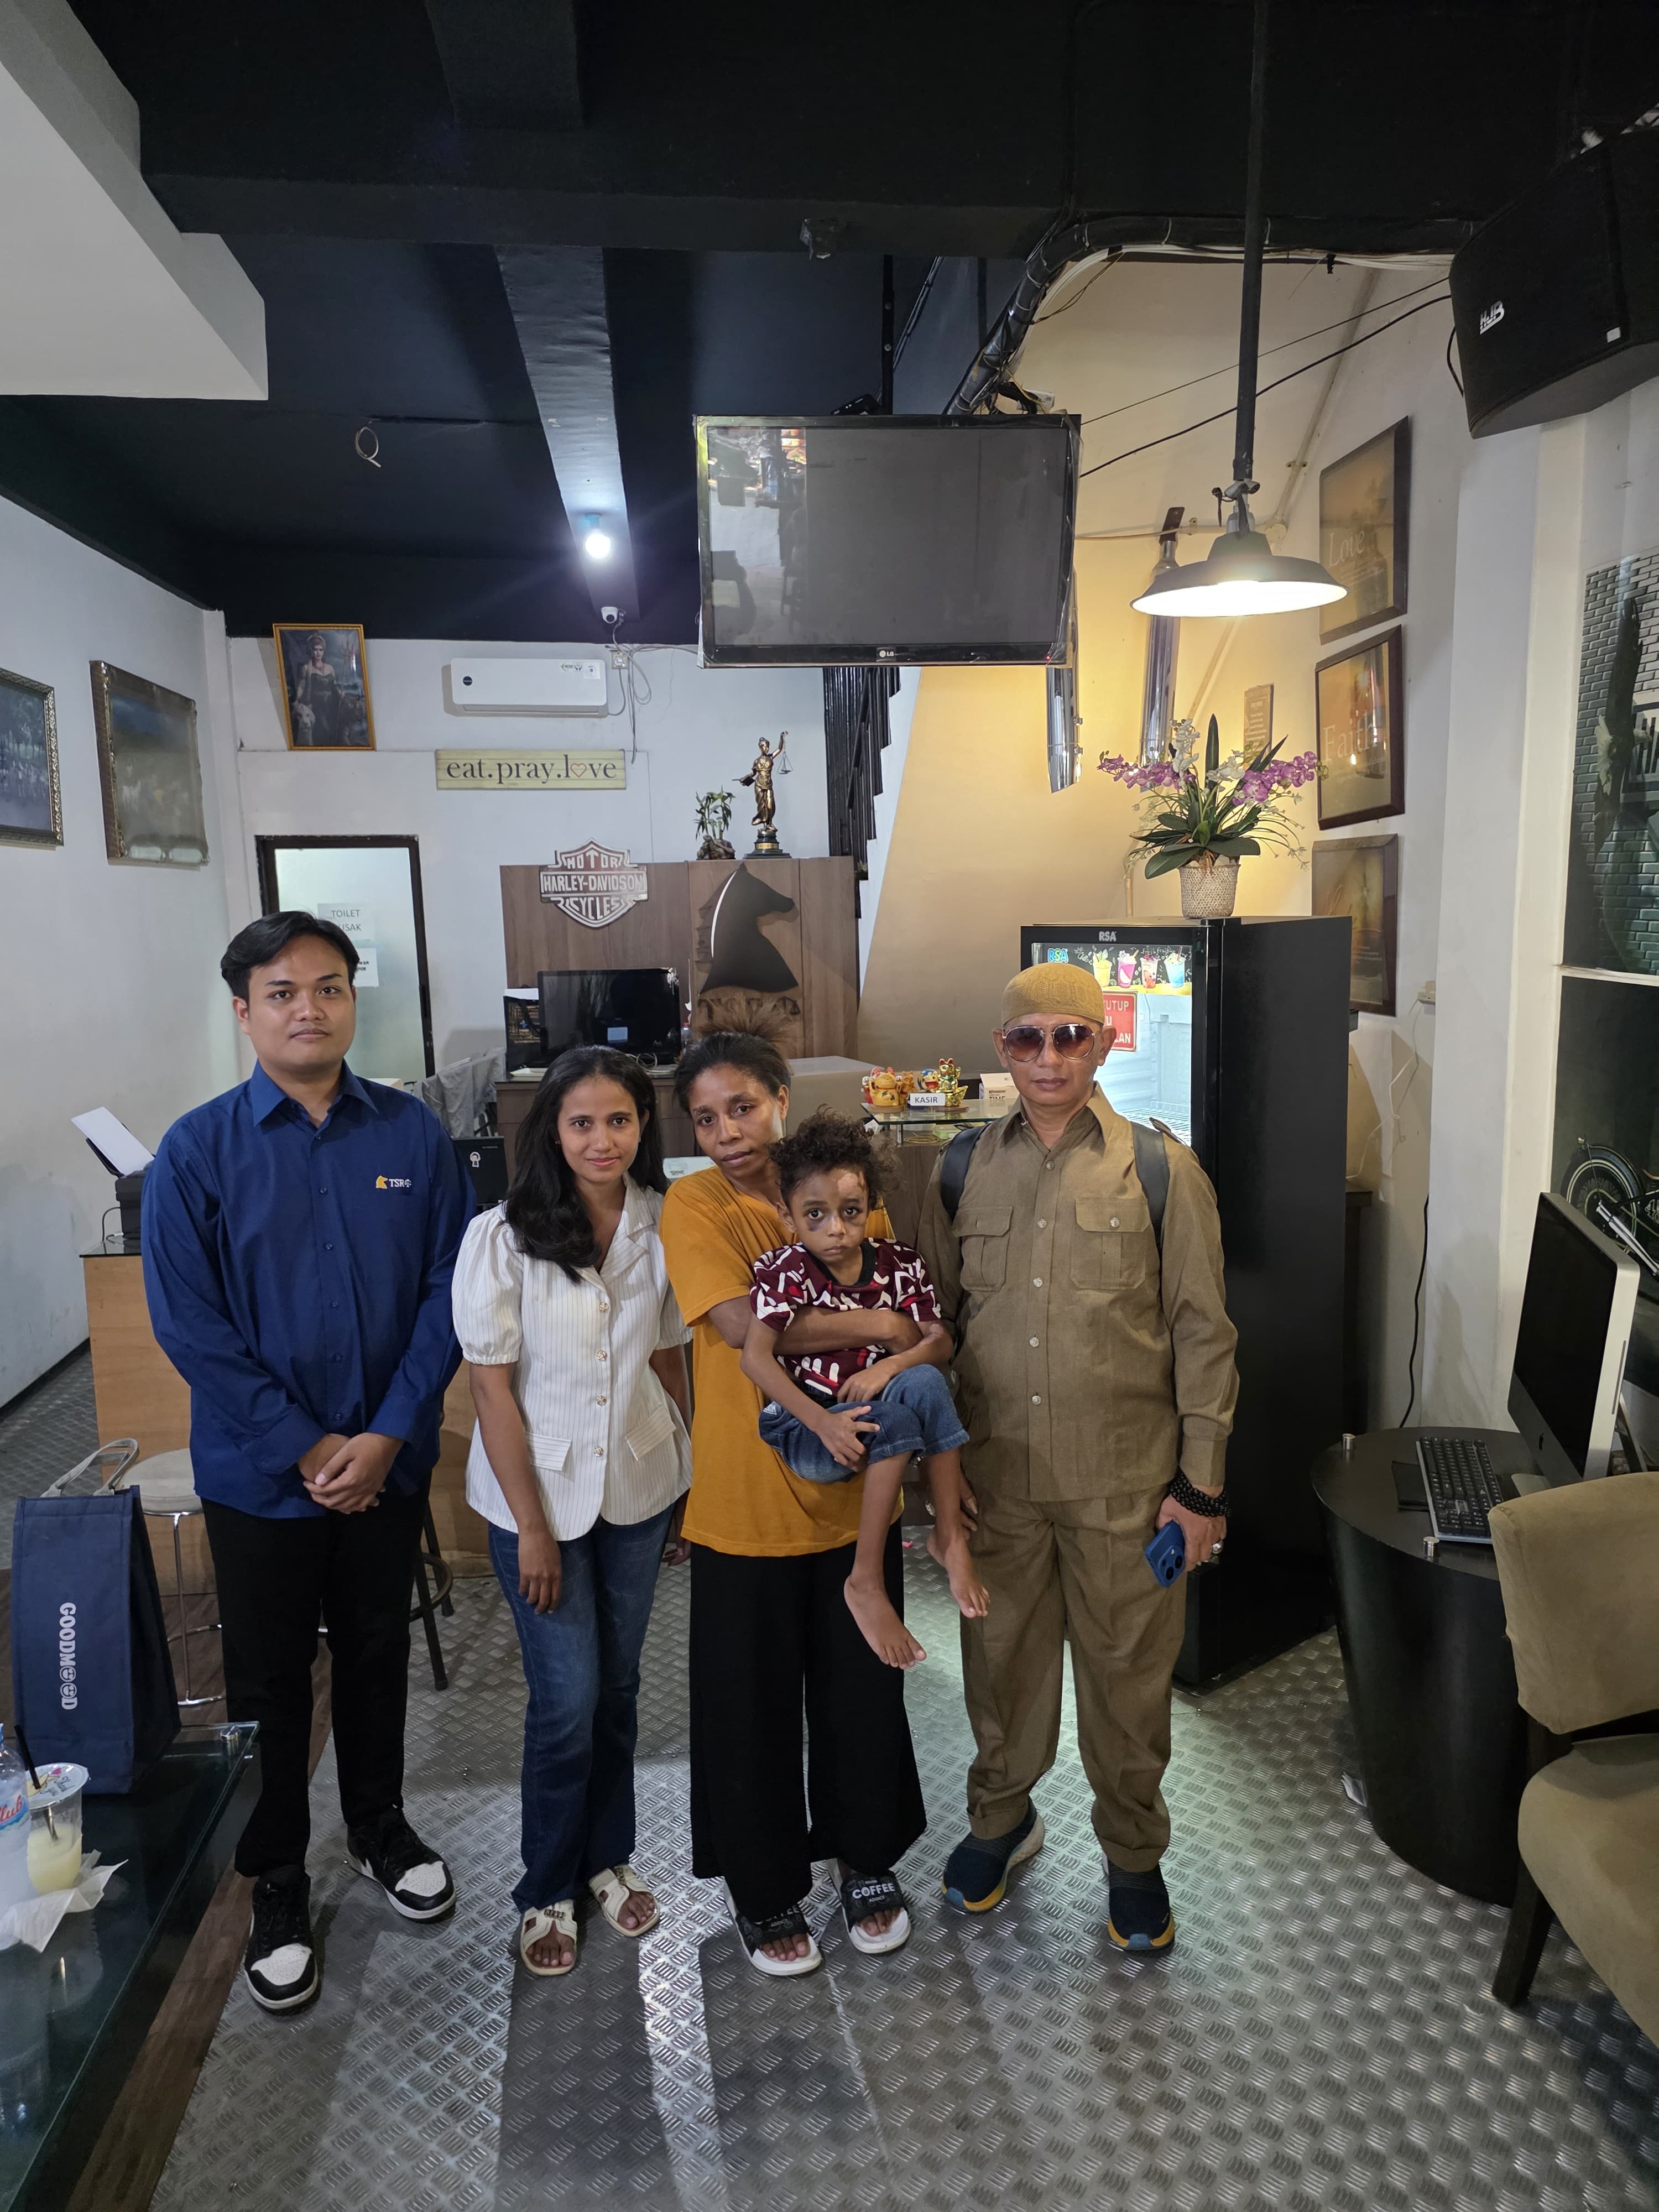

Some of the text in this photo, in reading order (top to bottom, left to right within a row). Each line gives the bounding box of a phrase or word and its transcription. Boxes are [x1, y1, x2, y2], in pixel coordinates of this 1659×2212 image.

[1328, 530, 1365, 567] Love
[1322, 708, 1378, 764] Faith
[567, 849, 619, 869] MOTOR
[543, 874, 646, 893] HARLEY-DAVIDSON
[331, 909, 361, 918] TOILET
[568, 896, 620, 920] CYCLES
[1098, 931, 1117, 942] RSA
[1047, 948, 1069, 963] RSA
[1104, 1000, 1129, 1011] UTUP
[0, 1794, 22, 1823] lub
[852, 1882, 895, 1899] COFFEE
